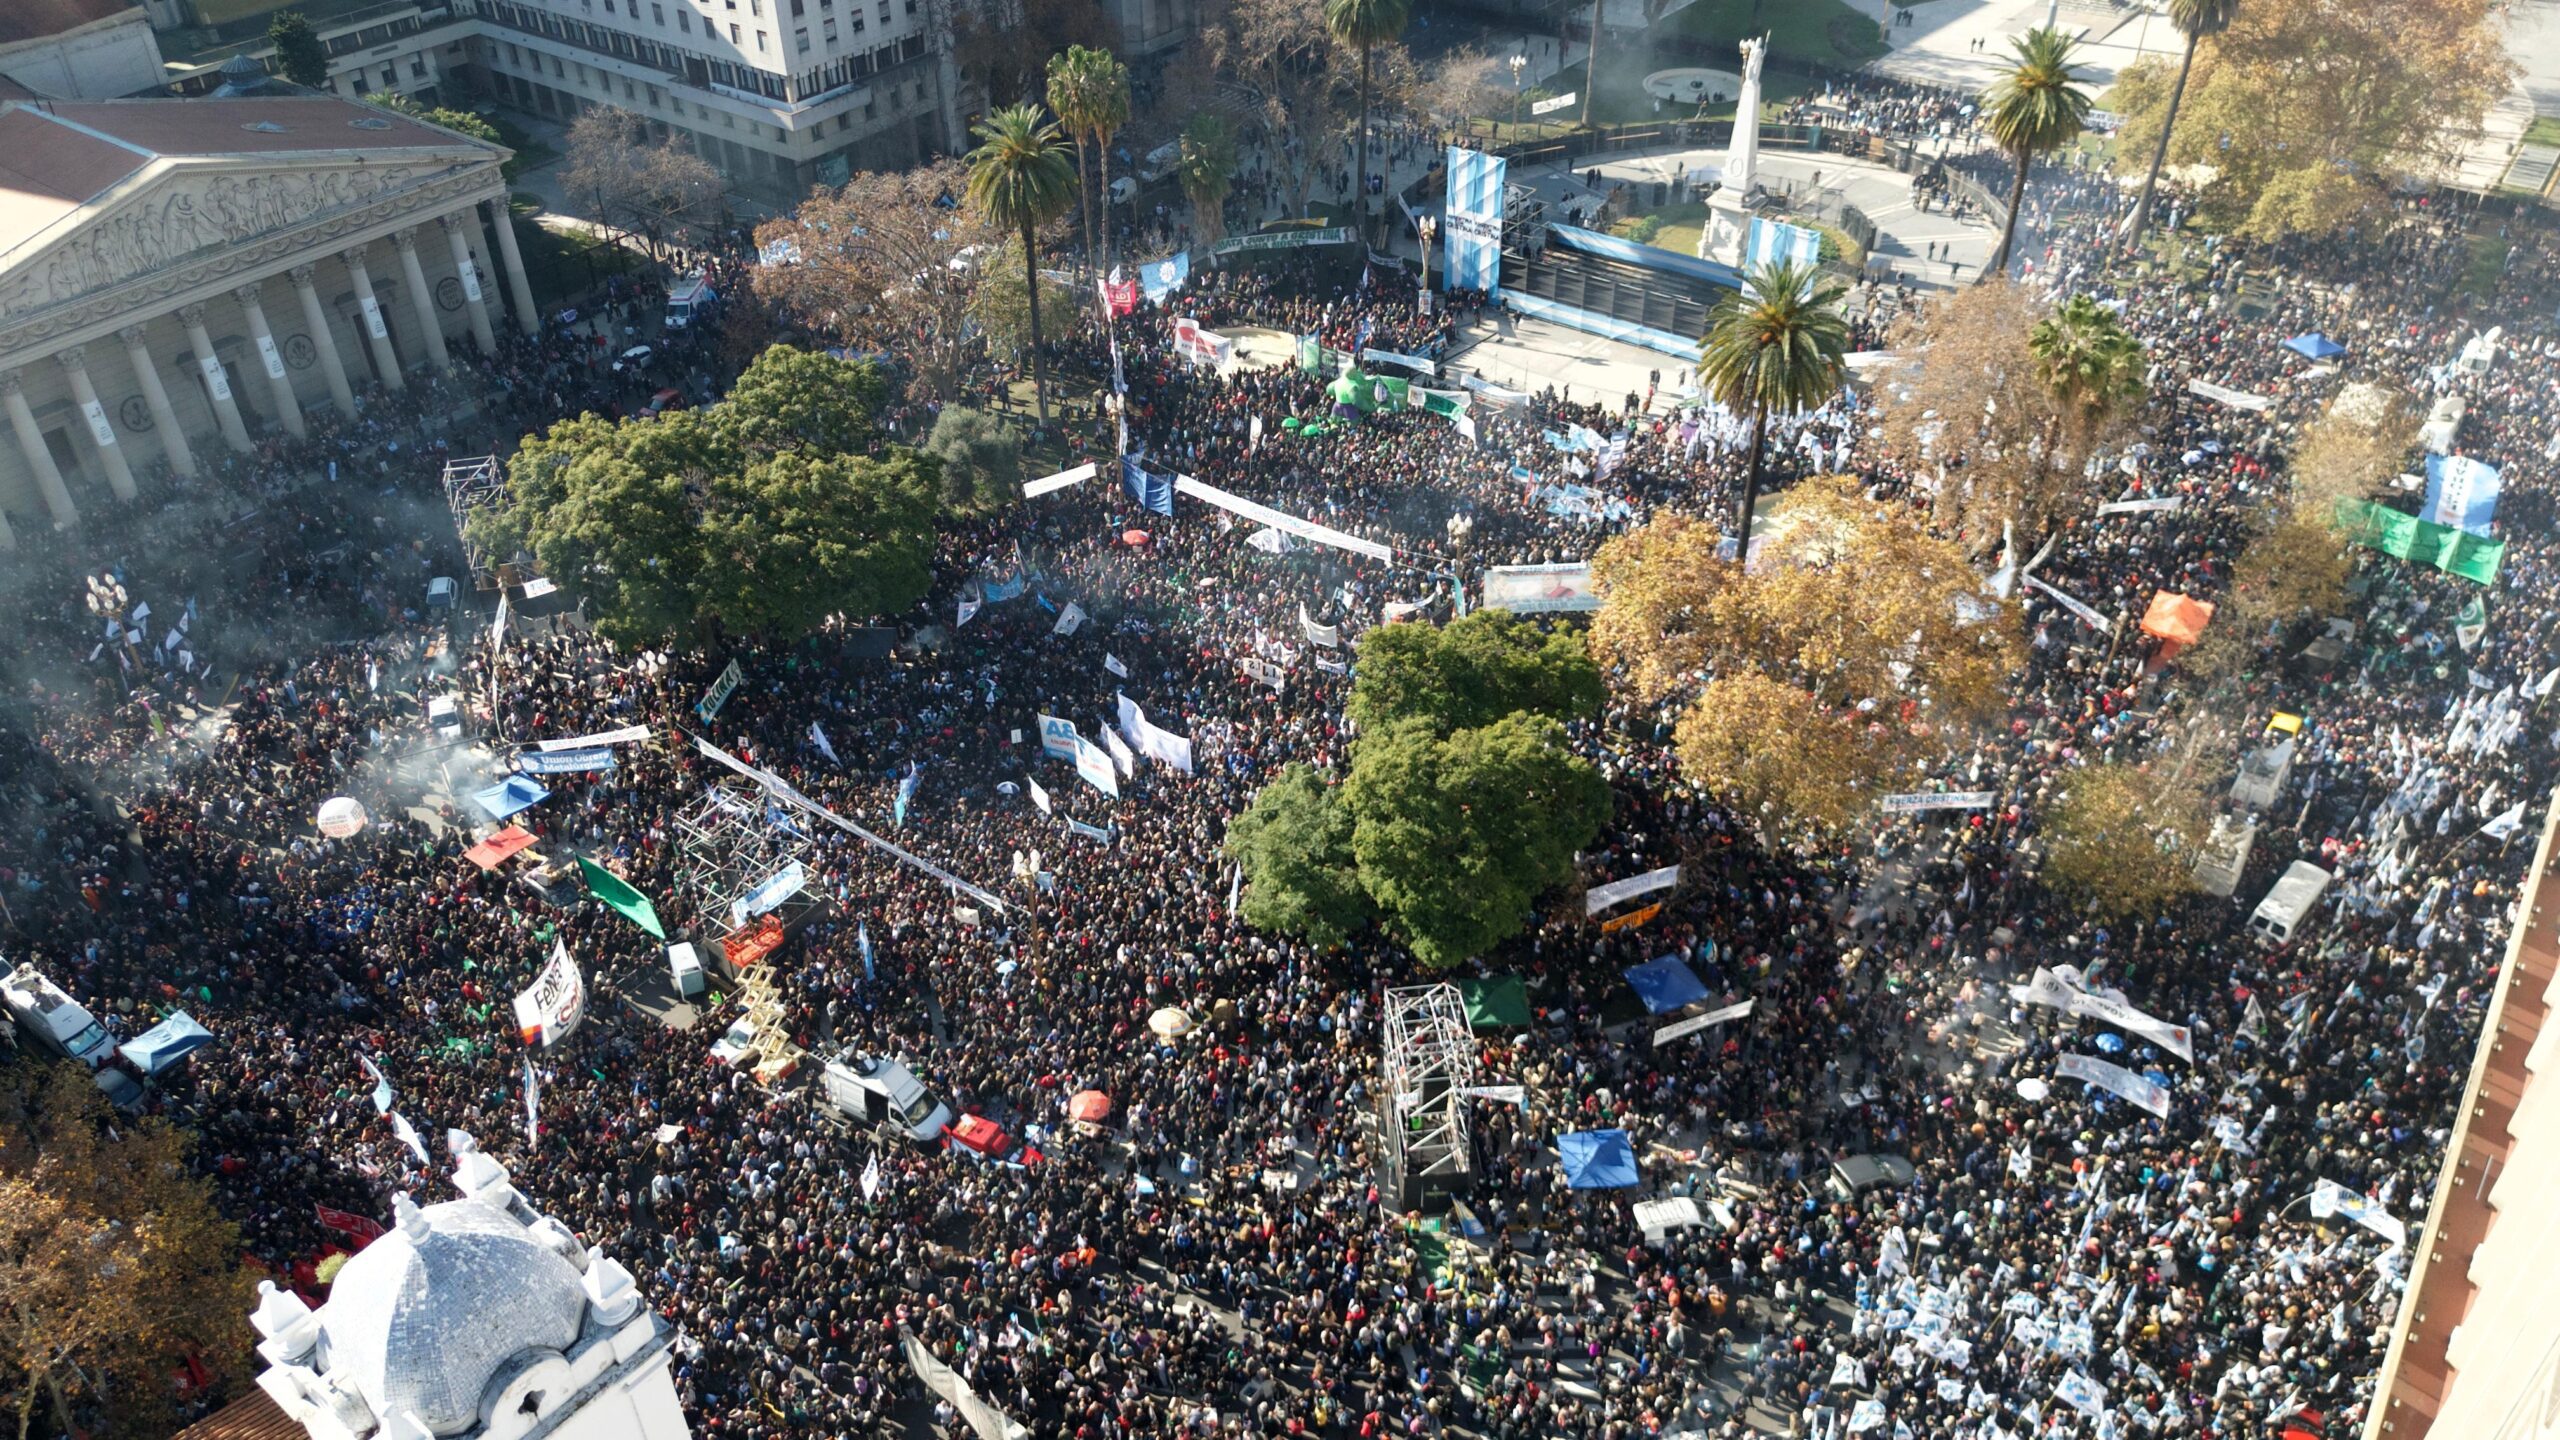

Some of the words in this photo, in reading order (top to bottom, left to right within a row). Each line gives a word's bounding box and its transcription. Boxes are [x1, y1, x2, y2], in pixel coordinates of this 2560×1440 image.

[1290, 228, 1340, 242] CRISTINA
[541, 754, 573, 764] Unión
[574, 751, 609, 763] Obrera
[1888, 796, 1923, 805] FUERZA
